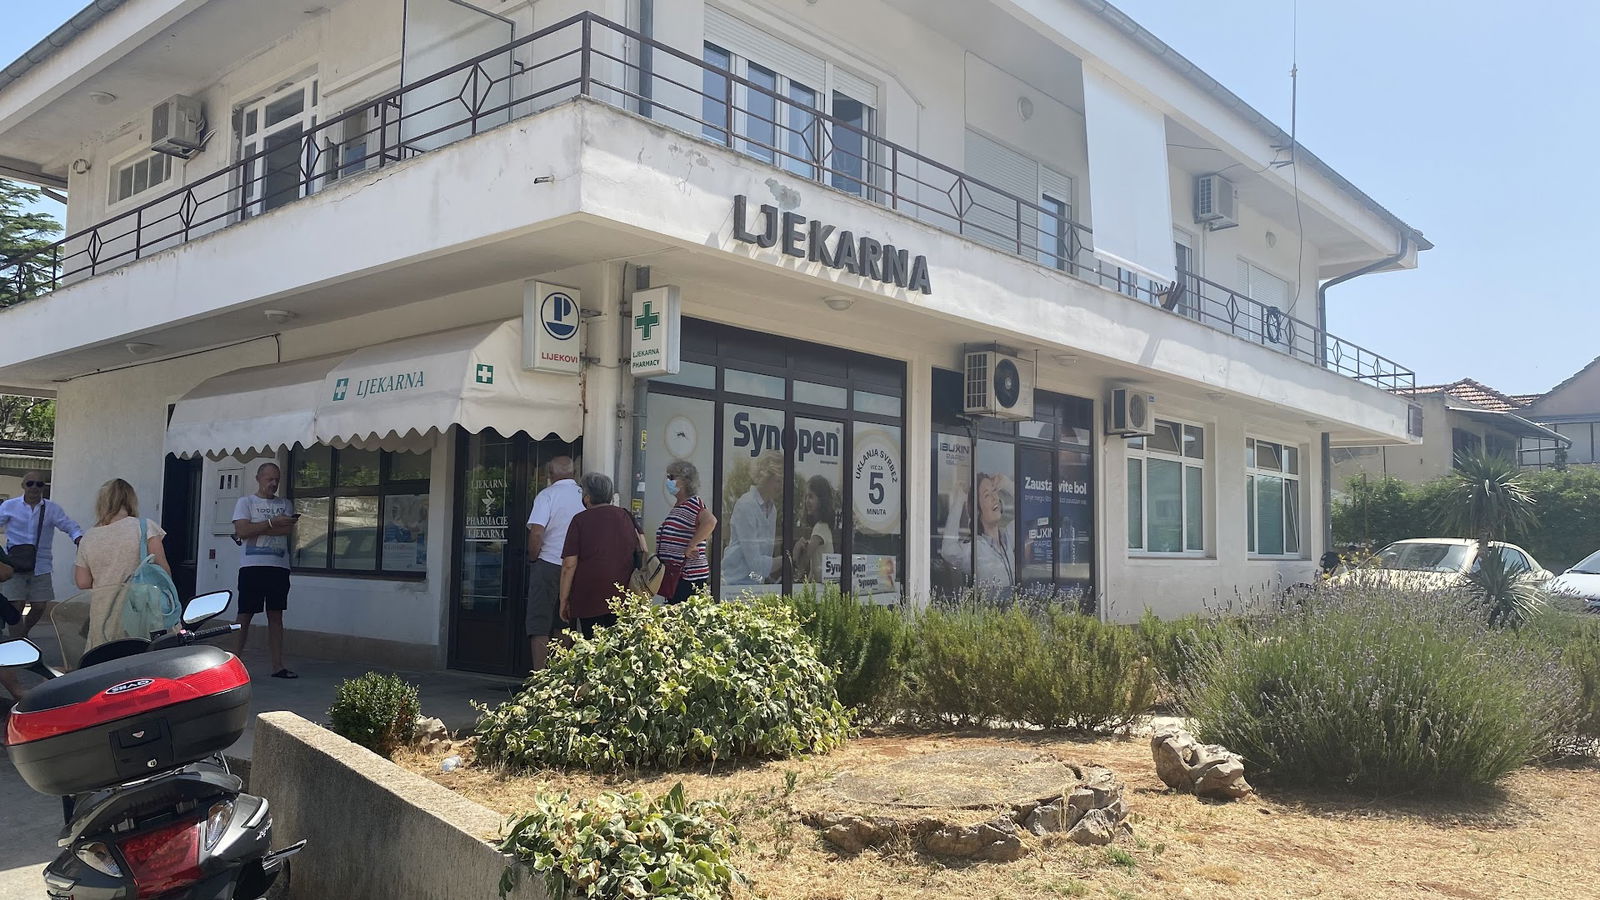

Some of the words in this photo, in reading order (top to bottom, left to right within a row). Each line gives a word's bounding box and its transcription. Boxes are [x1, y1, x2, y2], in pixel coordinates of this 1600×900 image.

[733, 194, 932, 295] LJEKARNA
[541, 352, 578, 364] LIJEKOVI
[632, 348, 660, 358] LJEKARNA
[632, 359, 660, 369] PHARMACY
[356, 370, 425, 400] LJEKARNA
[855, 448, 879, 480] UKLANJA
[471, 479, 508, 490] LJEKARNA
[868, 471, 885, 505] 5
[1024, 477, 1072, 494] Zaustavite
[1073, 481, 1087, 495] bol
[866, 508, 887, 516] MINUTA
[466, 516, 509, 526] PHARMACIE
[468, 529, 505, 539] LJEKARNA
[825, 561, 866, 577] Synpen
[111, 680, 150, 692] SHAD
